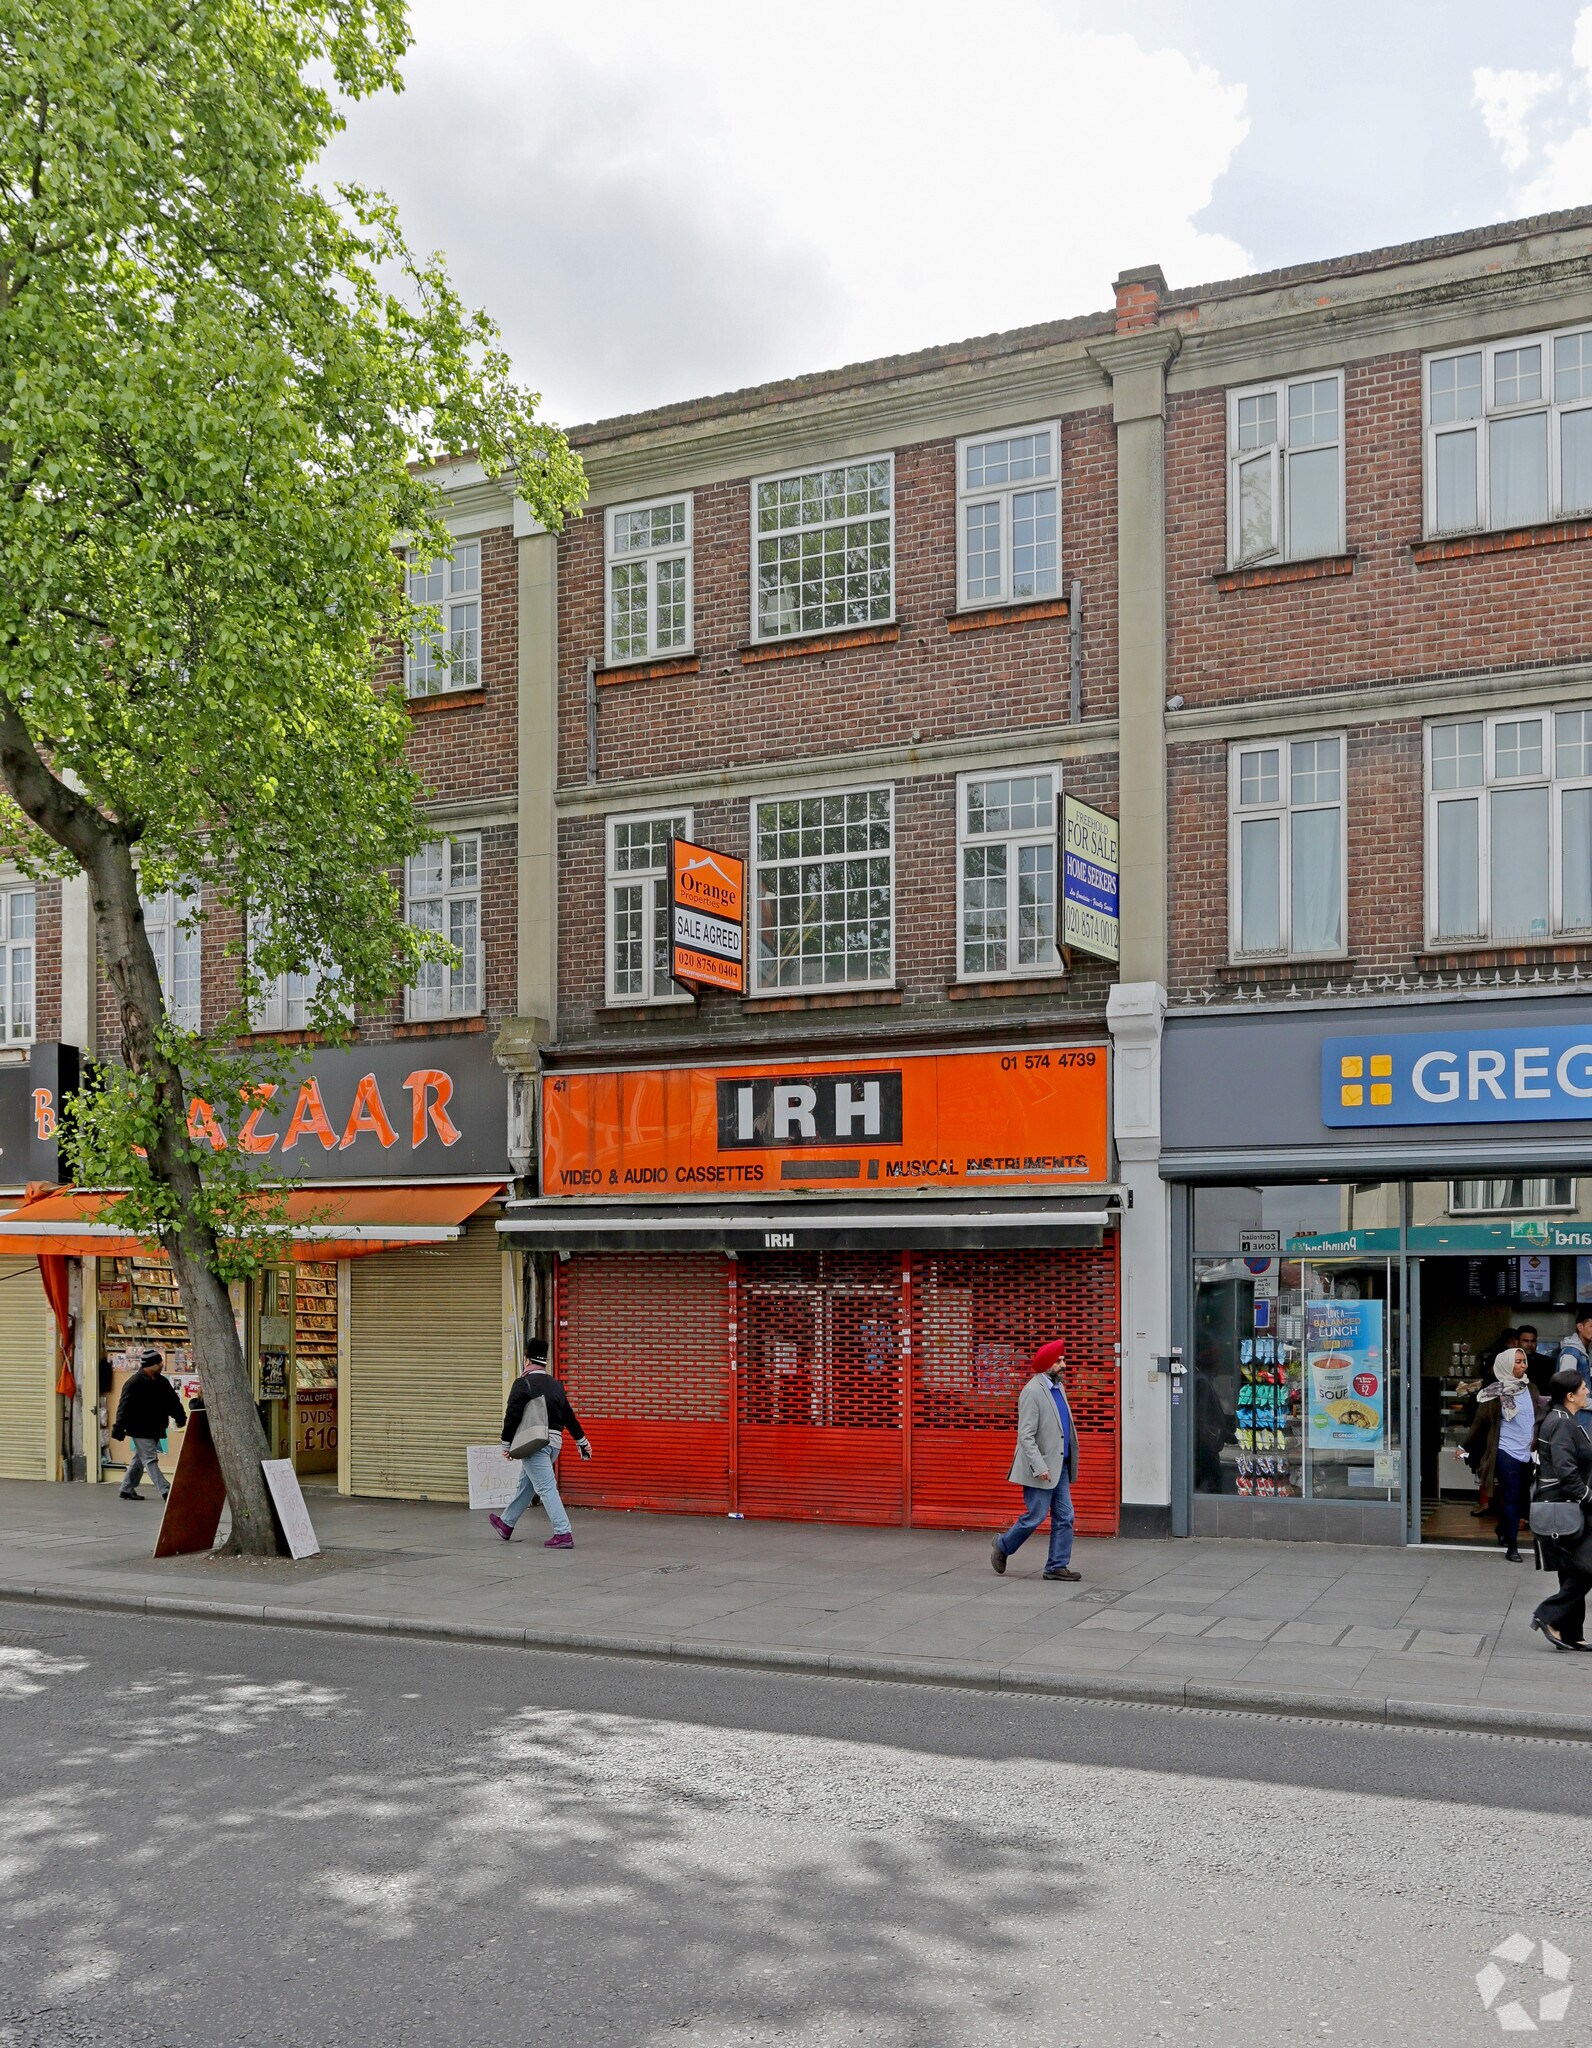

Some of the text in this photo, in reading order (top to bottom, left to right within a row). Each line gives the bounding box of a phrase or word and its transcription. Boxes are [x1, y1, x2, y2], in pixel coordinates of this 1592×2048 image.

[1076, 811, 1109, 835] FREEHOLD
[1068, 819, 1117, 863] FOR SALE
[1067, 855, 1117, 895] HOME SEEKERS
[681, 872, 736, 907] Orange
[681, 890, 721, 909] Properties
[678, 916, 740, 950] SALE AGREED
[1066, 905, 1080, 934] 020
[1082, 911, 1099, 942] 8574
[1101, 919, 1118, 949] 0012
[679, 952, 738, 979] 020 8756 0404
[1001, 1052, 1097, 1071] 01 574 4739
[1411, 1044, 1592, 1103] GREG
[553, 1079, 567, 1093] 41
[130, 1069, 462, 1157] AZAAR
[738, 1081, 881, 1140] IRH
[560, 1165, 764, 1185] VIDEO & AUDIO CASSETTES
[886, 1155, 1088, 1177] MUSICAL INSTRUMENTS
[765, 1233, 794, 1248] IRH
[1313, 1317, 1361, 1327] BALANCED
[1327, 1309, 1345, 1319] LOVE A
[1318, 1326, 1358, 1337] LUNCH
[296, 1393, 333, 1402] ECIAL OFFER
[1319, 1387, 1349, 1400] SOUP
[1361, 1385, 1370, 1395] £2
[301, 1410, 333, 1424] DVDS
[279, 1426, 338, 1451] fr £10
[472, 1447, 500, 1459] SPEC
